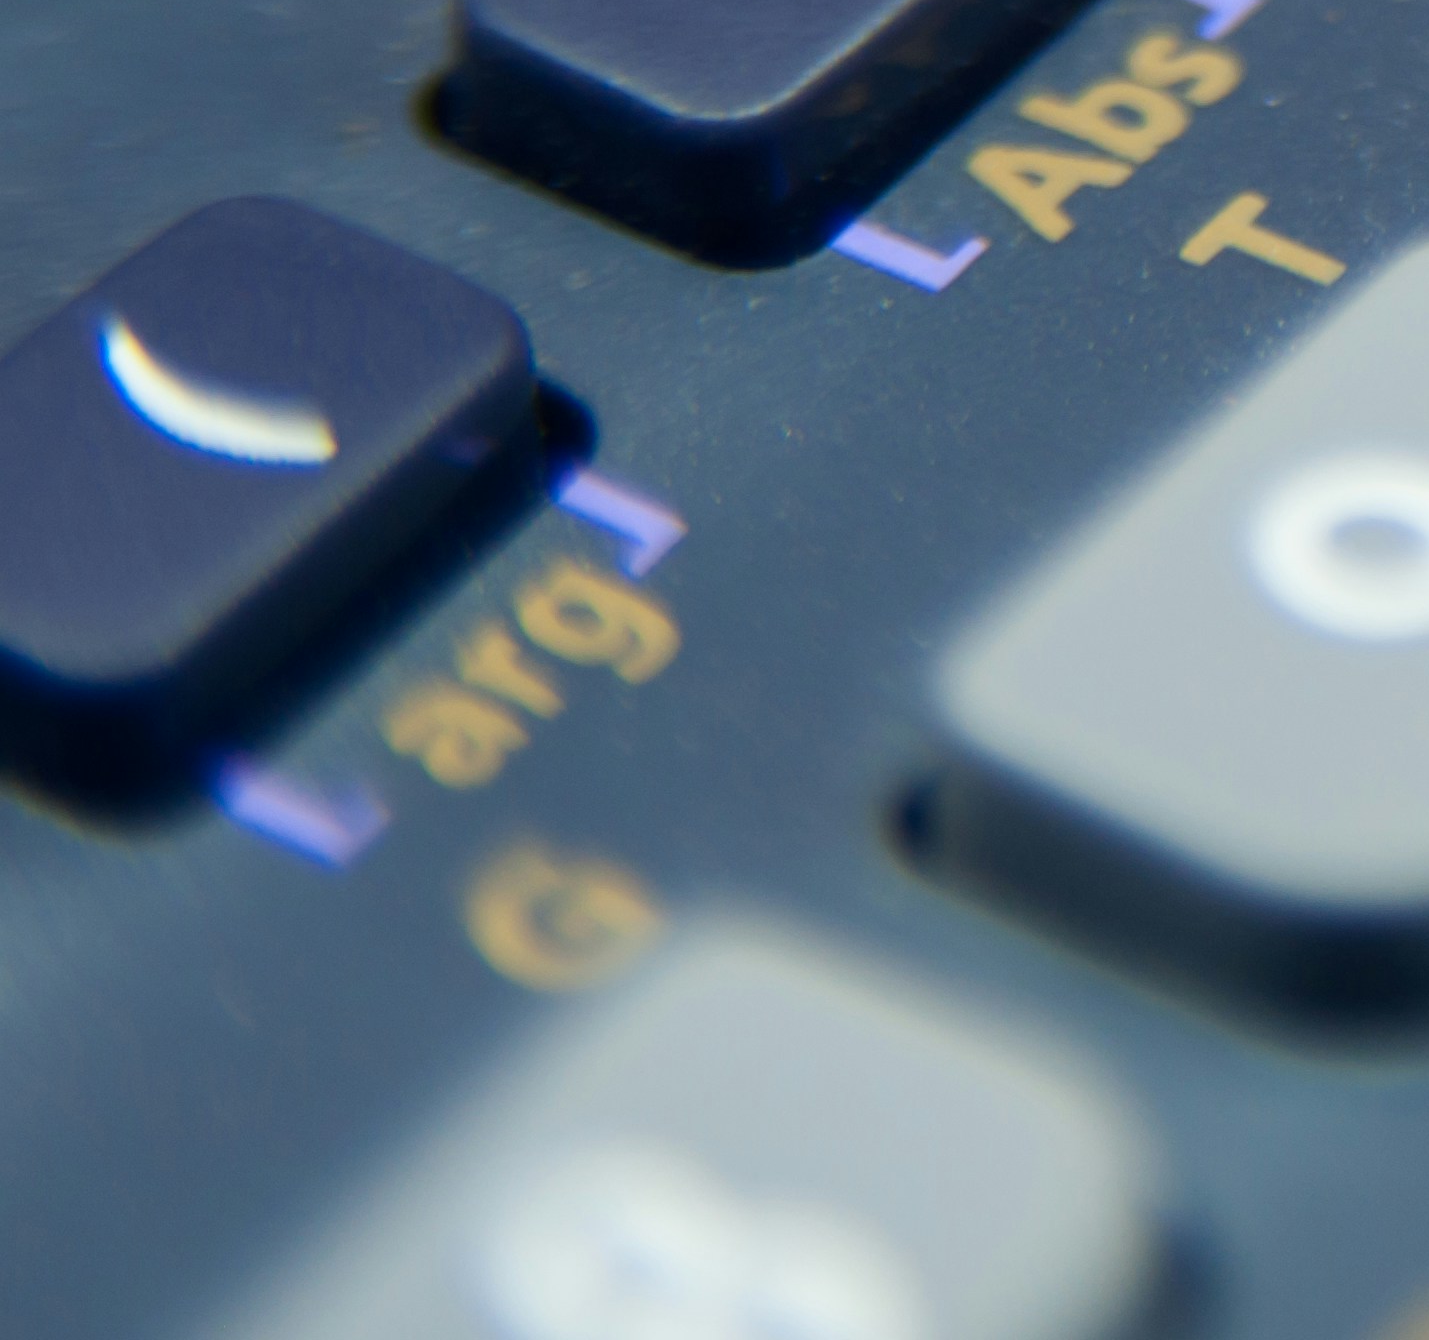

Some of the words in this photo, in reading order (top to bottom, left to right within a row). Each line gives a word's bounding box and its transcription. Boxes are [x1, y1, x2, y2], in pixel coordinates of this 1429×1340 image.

[968, 32, 1243, 244] Abs
[1178, 192, 1348, 287] T
[378, 560, 684, 790] arg
